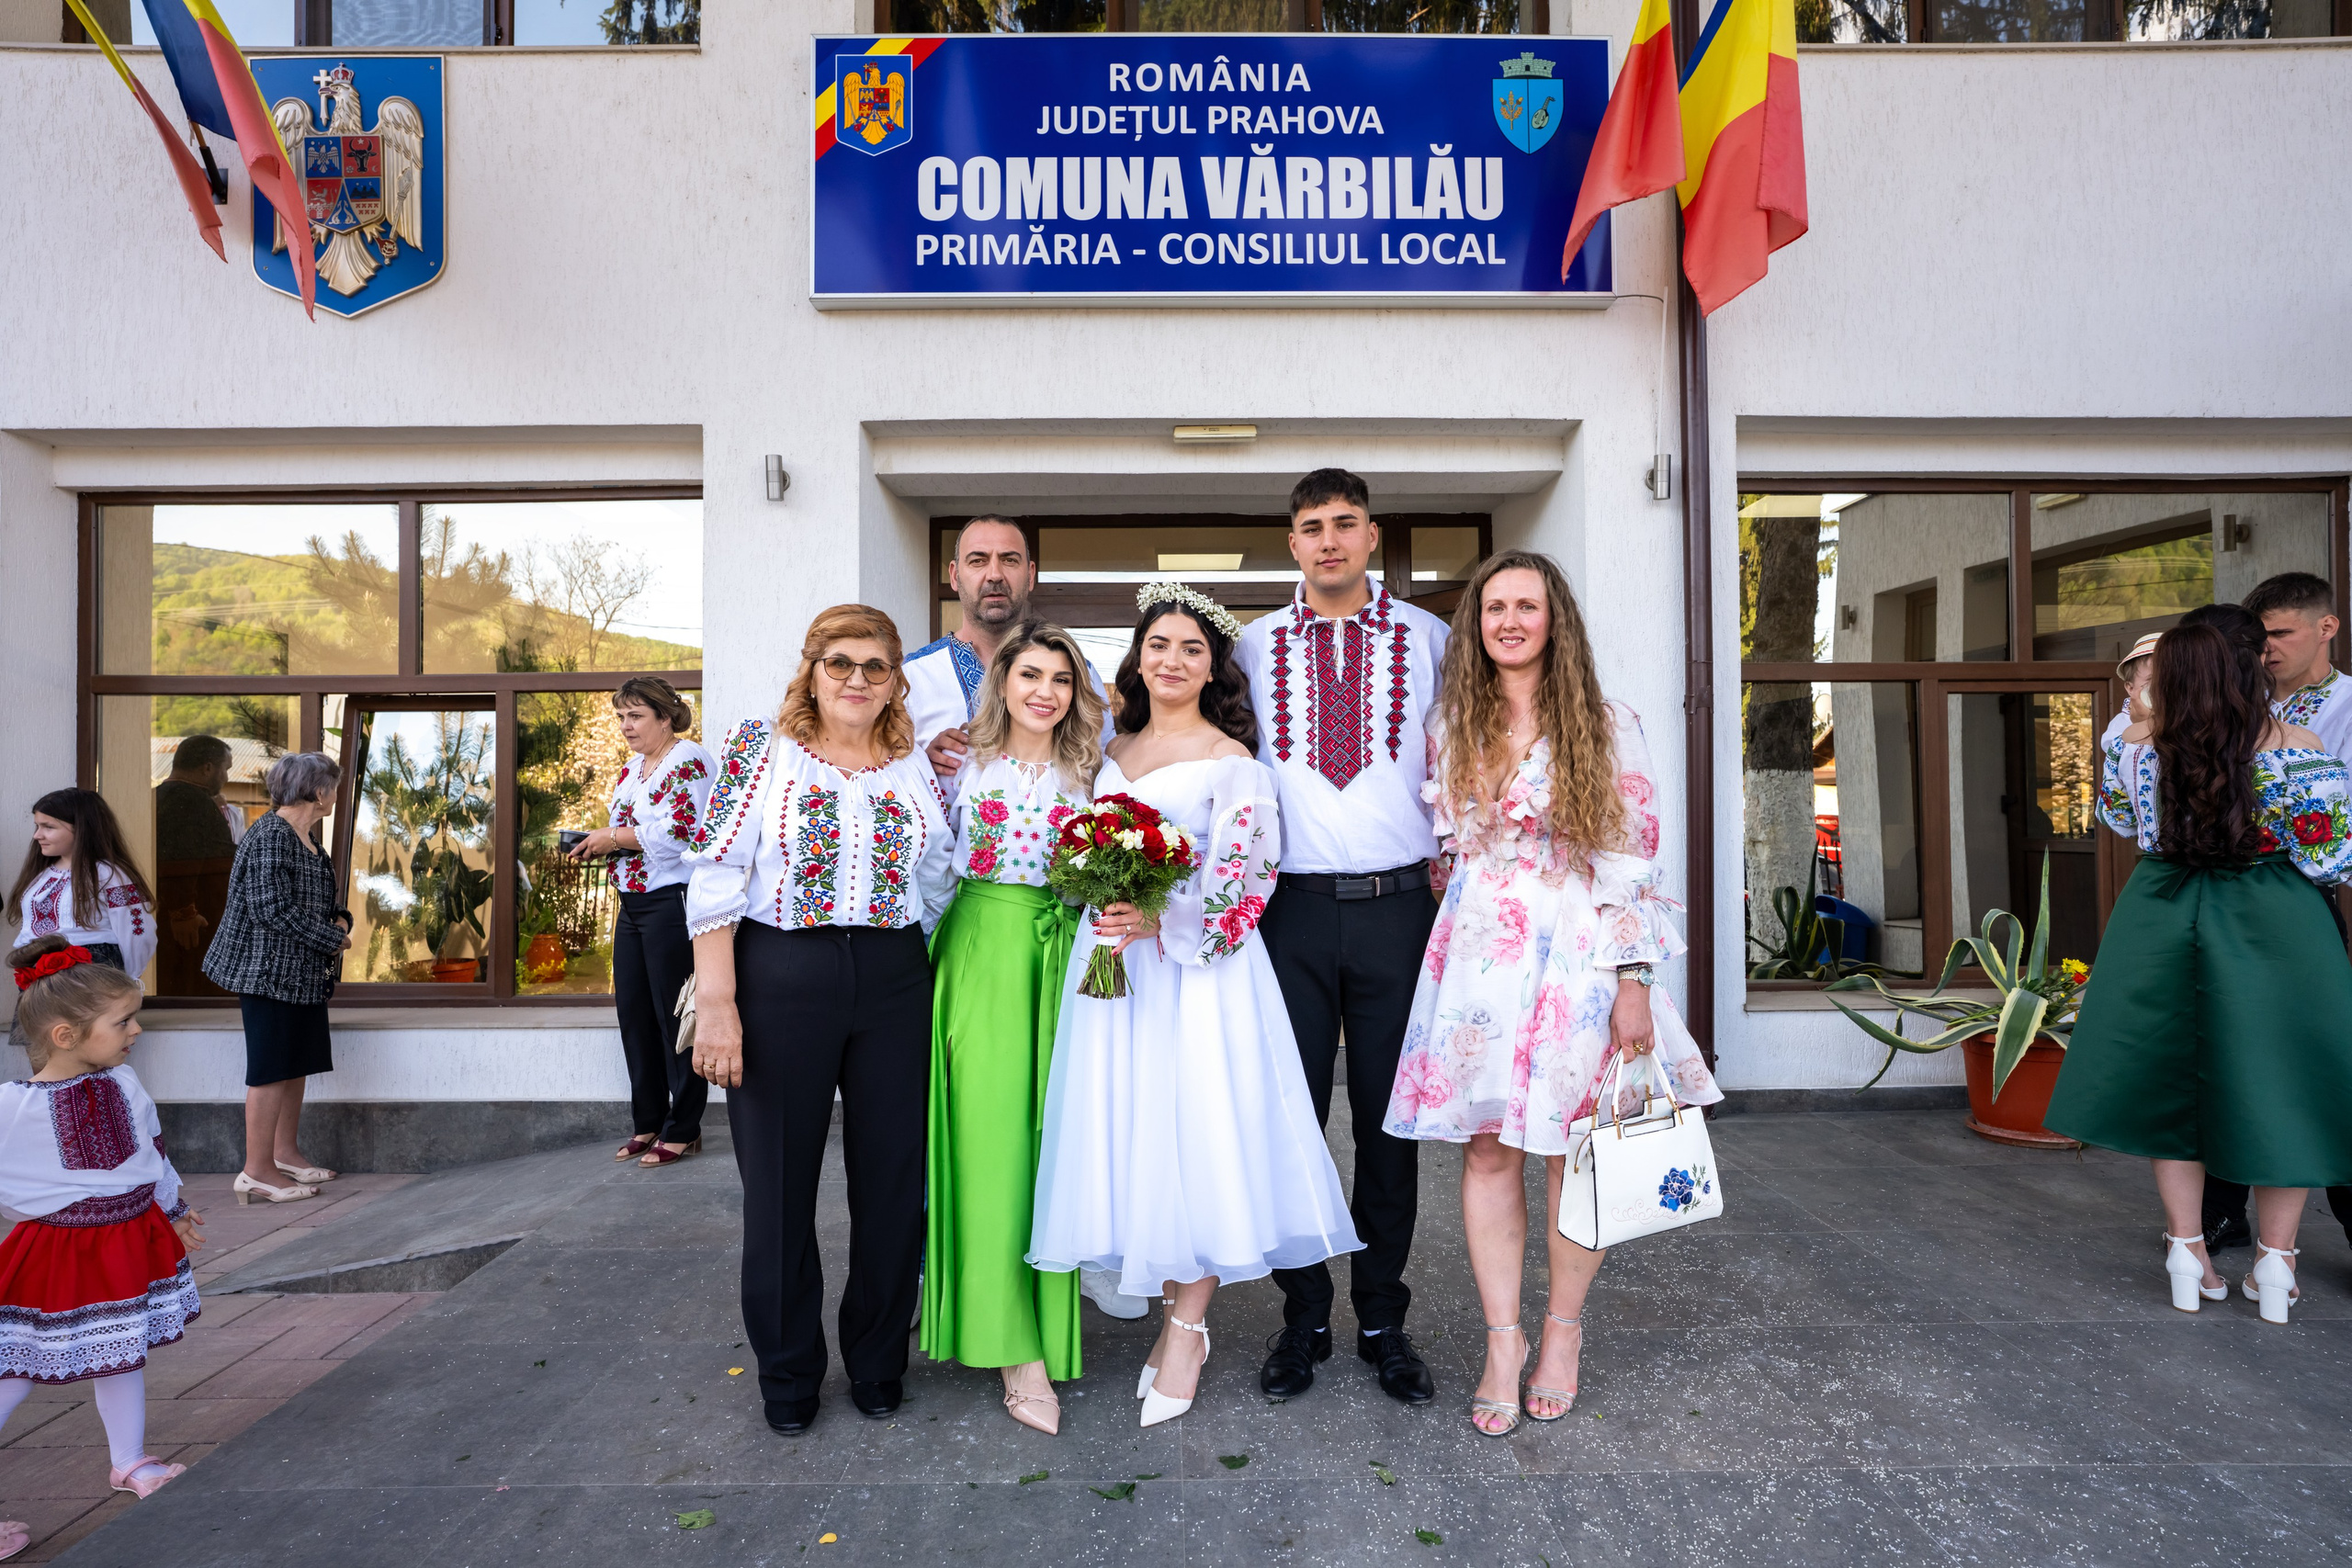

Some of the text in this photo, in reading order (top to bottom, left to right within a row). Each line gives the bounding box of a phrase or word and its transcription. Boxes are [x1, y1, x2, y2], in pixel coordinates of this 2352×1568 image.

[1109, 56, 1311, 92] ROMÂNIA
[1036, 105, 1385, 141] JUDEȚUL PRAHOVA
[918, 142, 1504, 221] COMUNA VĂRBILĂU
[916, 224, 1121, 265] PRIMĂRIA
[1159, 232, 1369, 265] CONSILIUL
[1381, 232, 1507, 265] LOCAL
